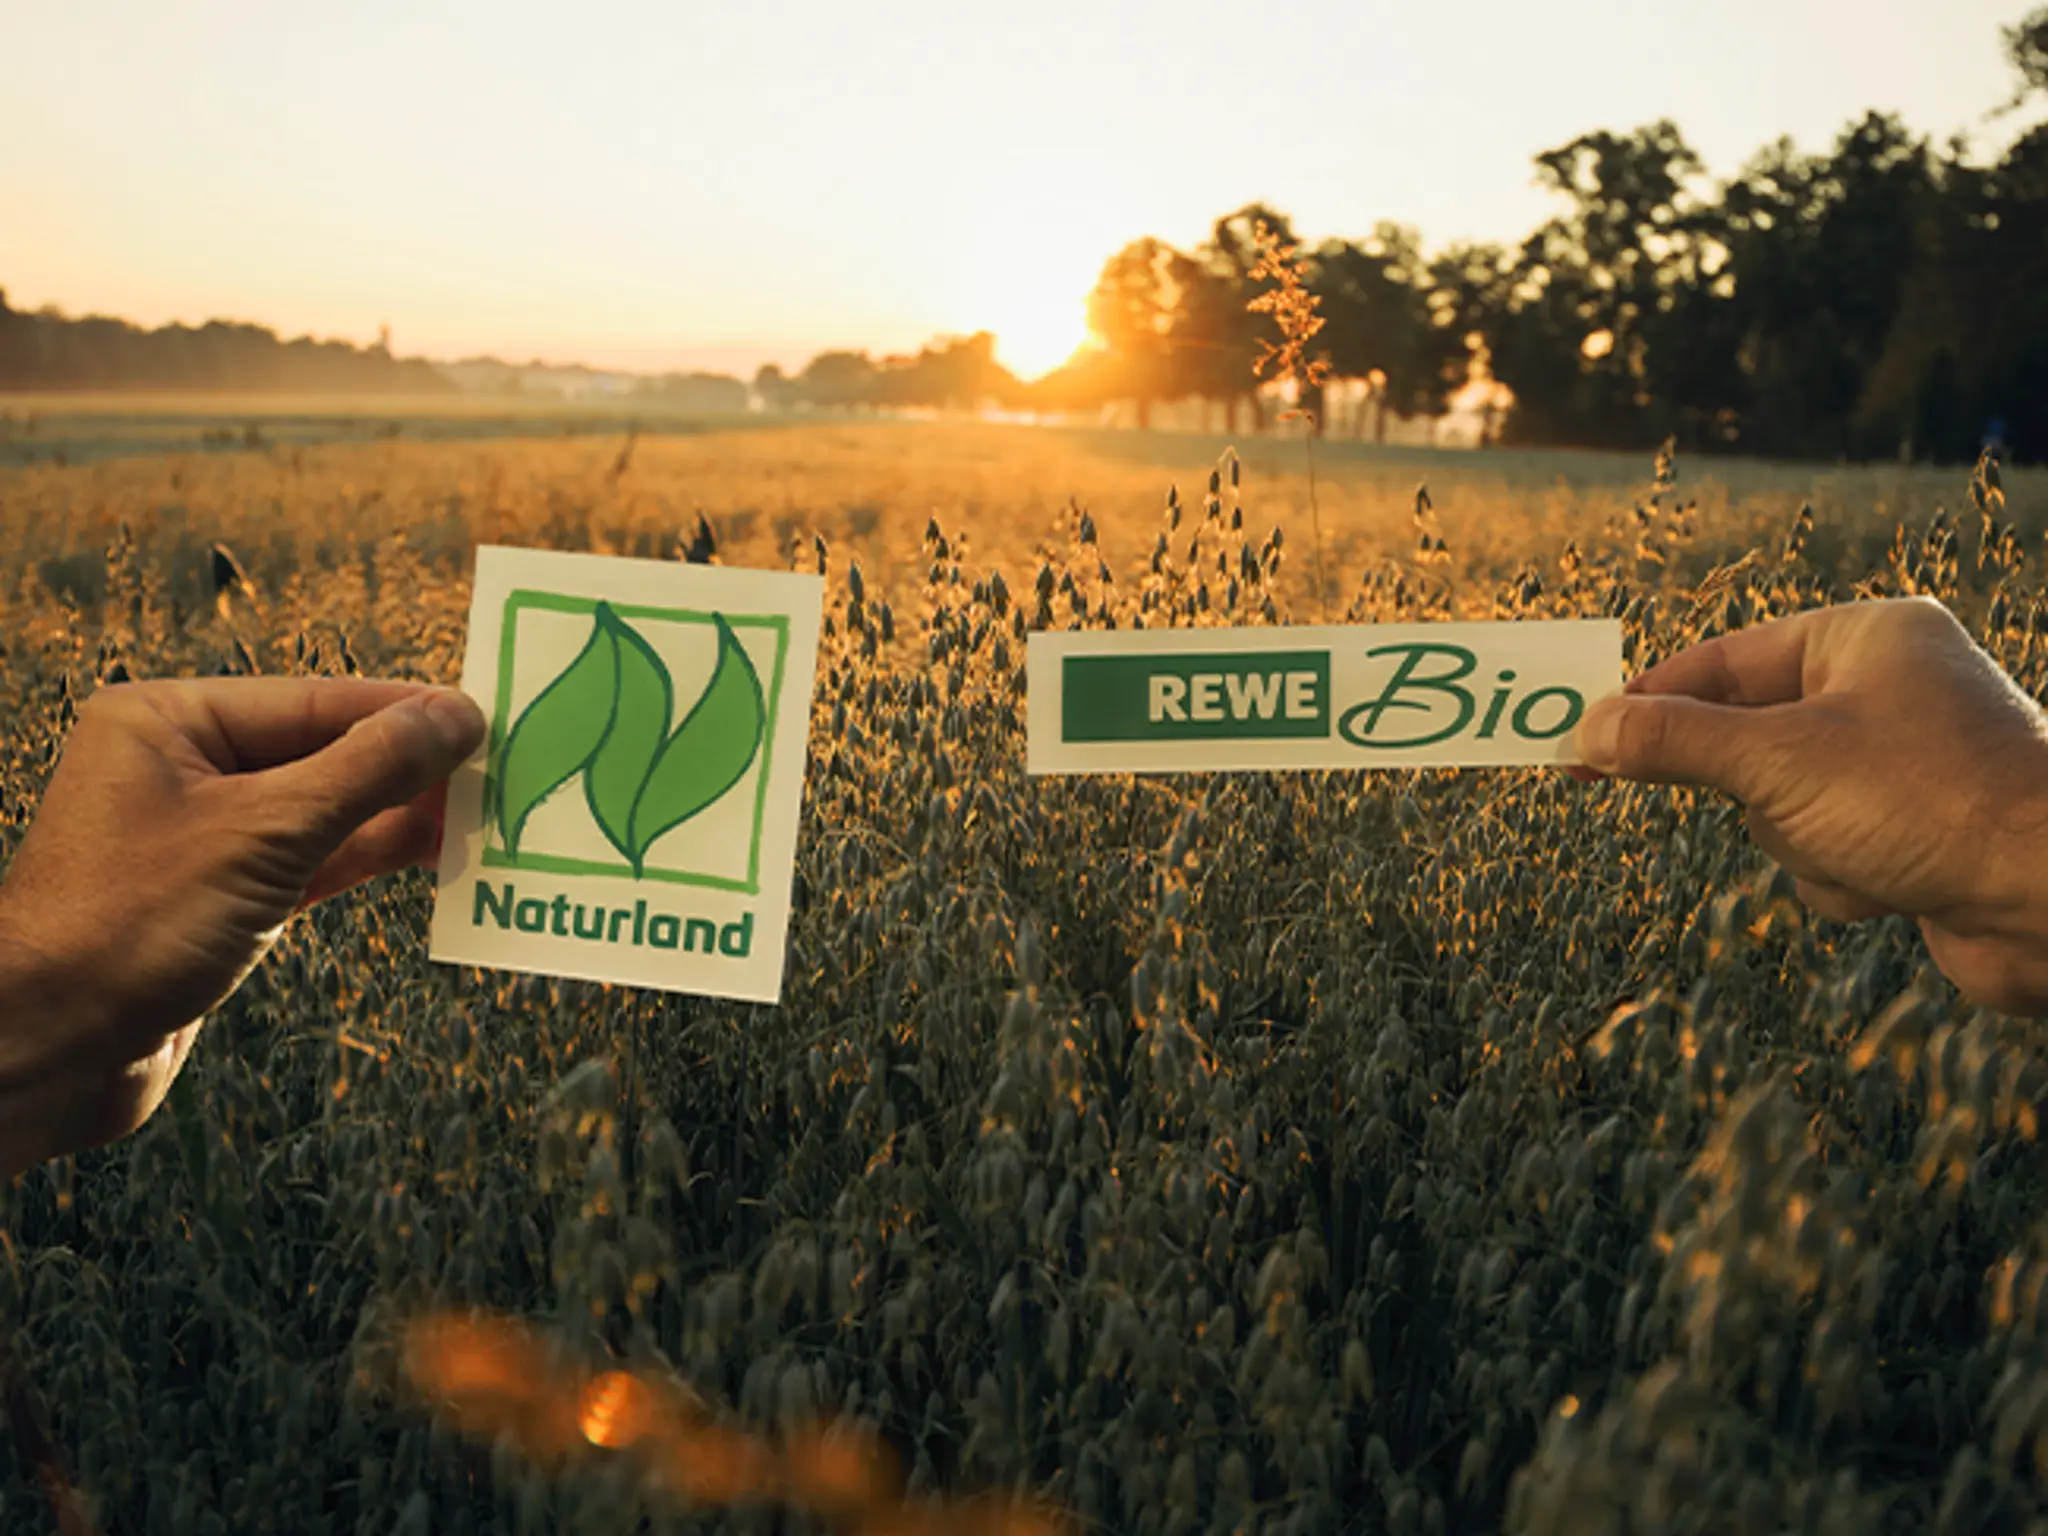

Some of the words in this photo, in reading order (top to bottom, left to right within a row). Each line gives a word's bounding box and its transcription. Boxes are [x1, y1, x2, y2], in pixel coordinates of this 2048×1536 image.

[1148, 671, 1320, 722] REWE
[1338, 643, 1585, 749] Bio
[472, 879, 754, 958] Naturland
